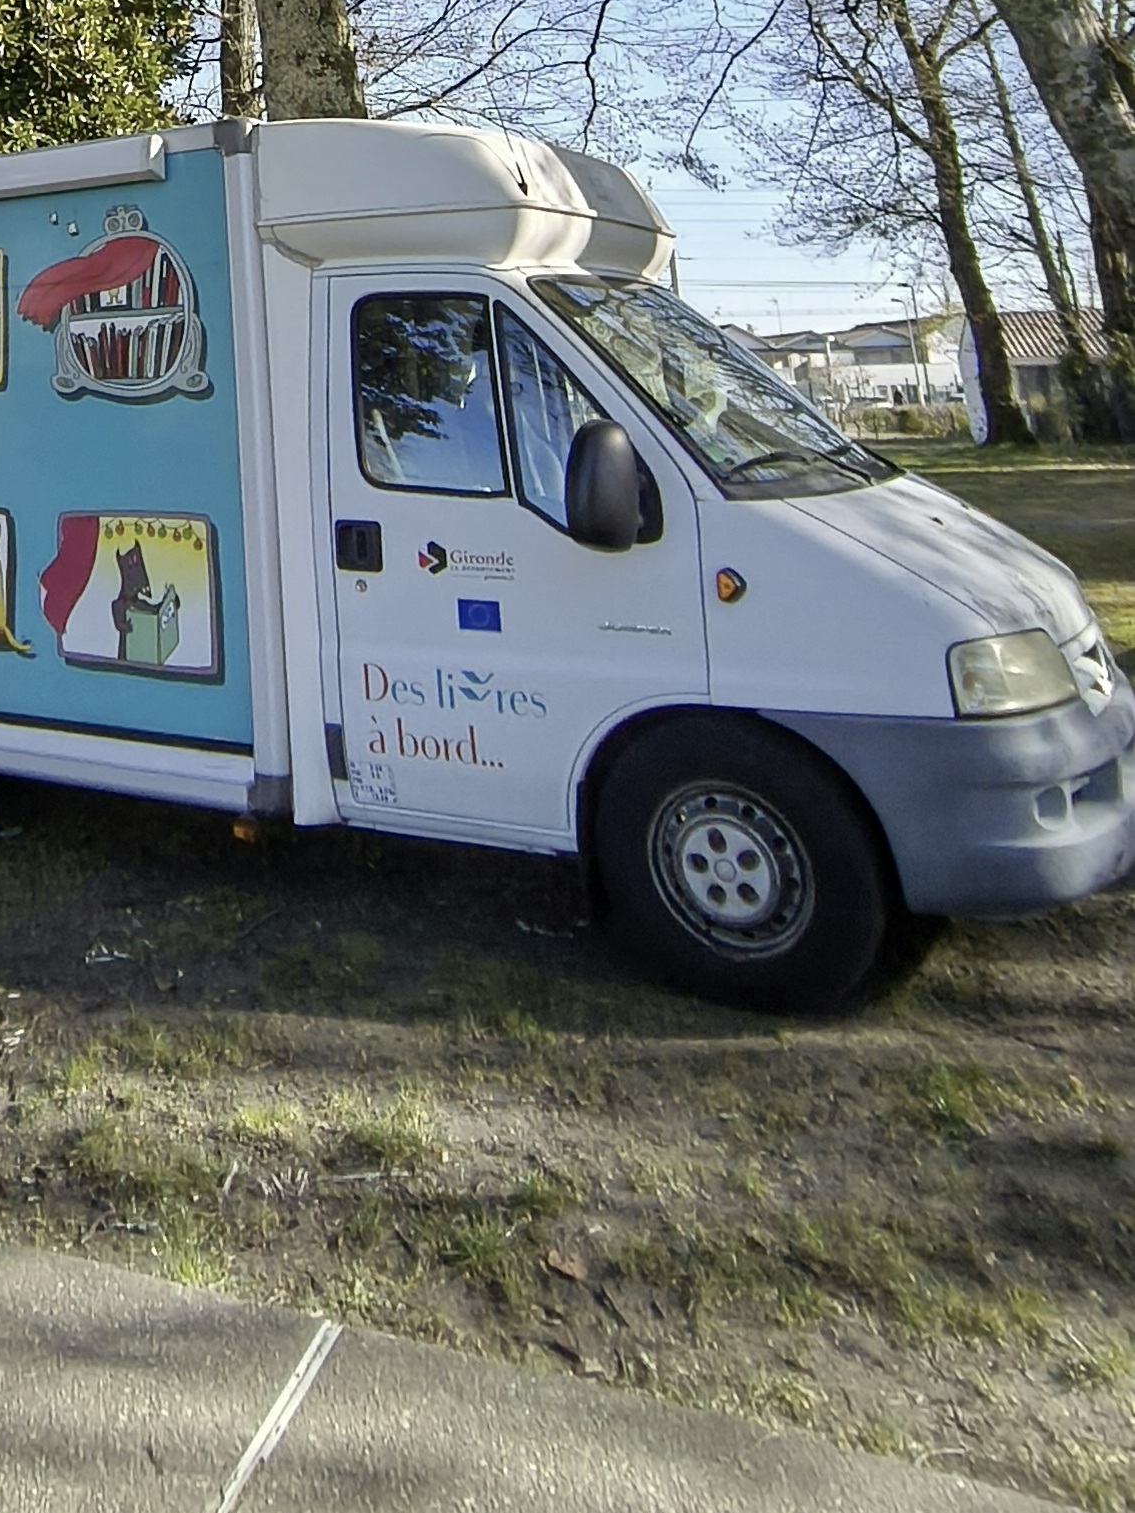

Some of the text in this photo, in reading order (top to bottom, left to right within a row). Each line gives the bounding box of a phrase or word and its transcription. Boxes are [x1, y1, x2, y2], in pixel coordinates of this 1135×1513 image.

[450, 549, 514, 566] Gironde
[364, 663, 547, 718] Des livres
[369, 715, 503, 768] à bord...
